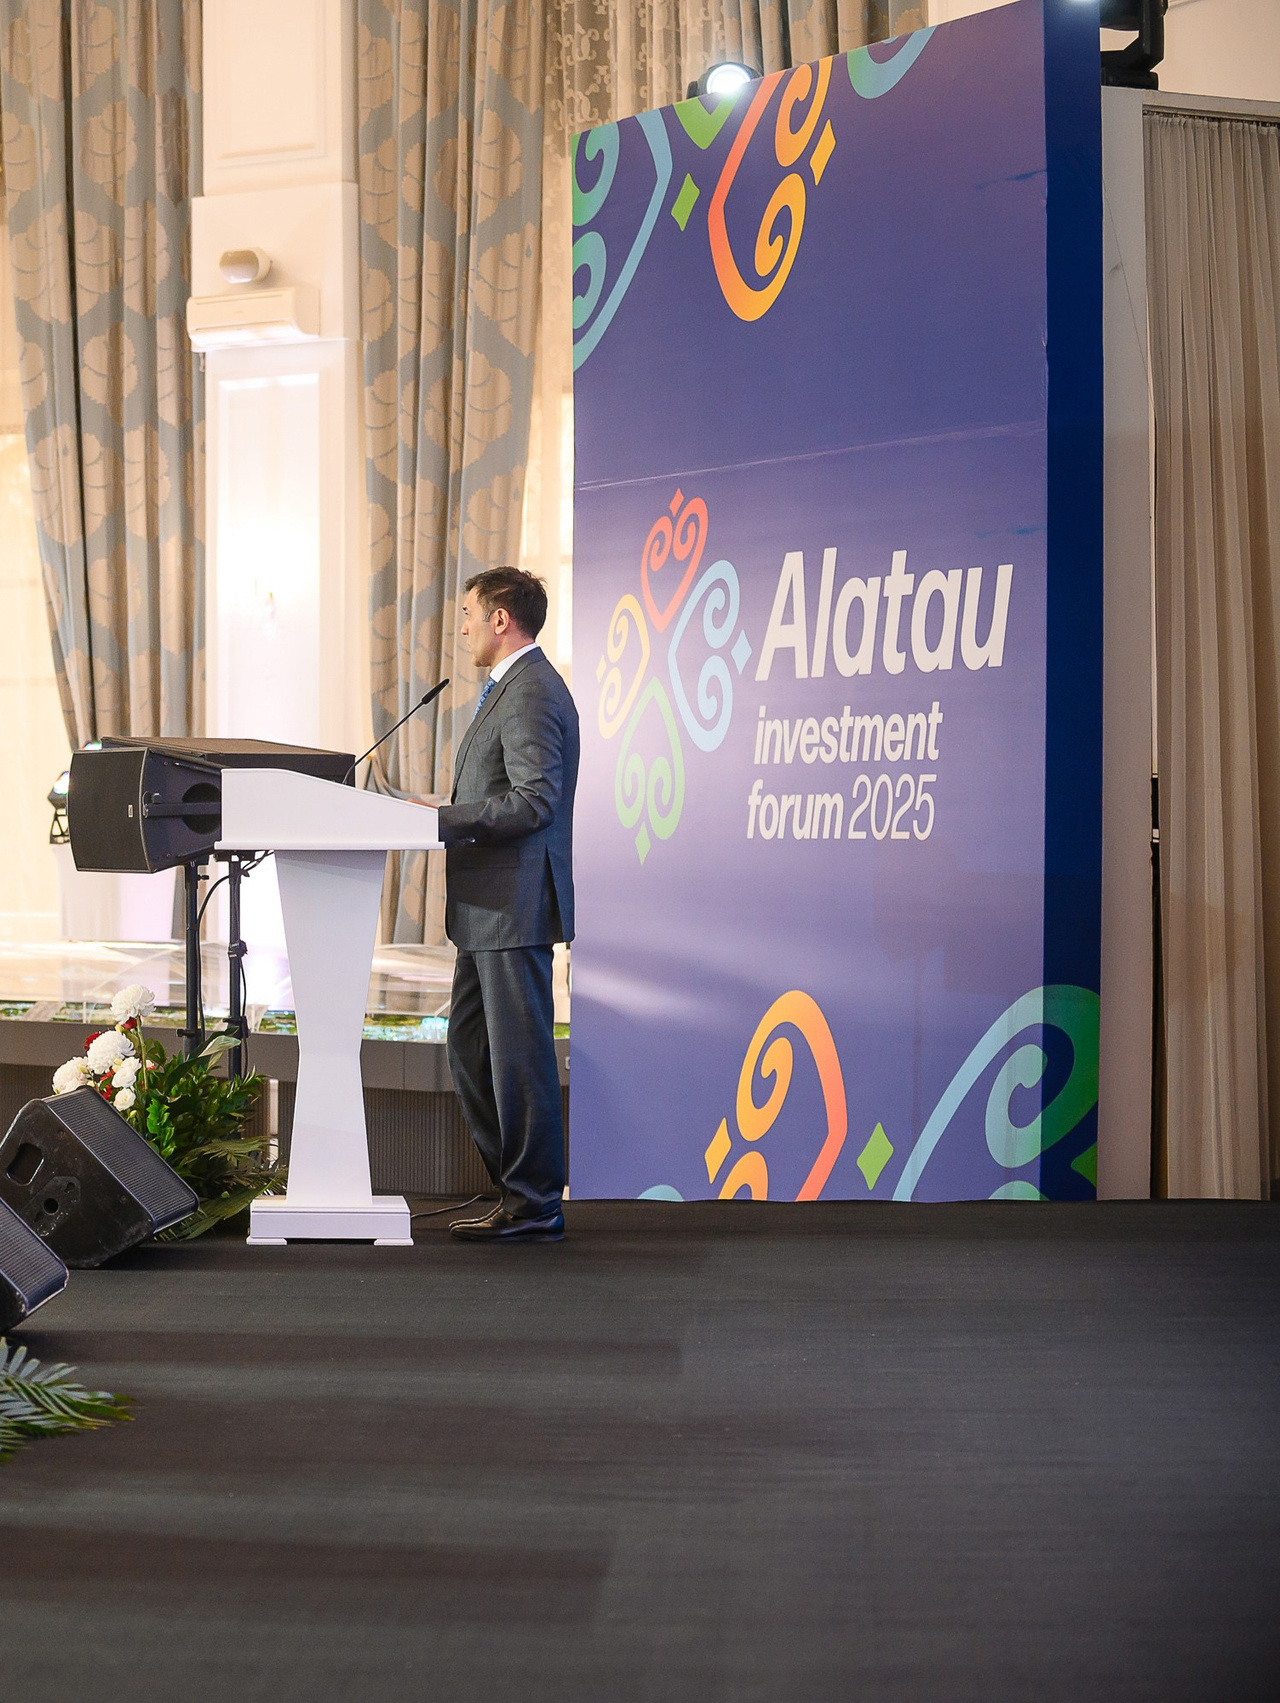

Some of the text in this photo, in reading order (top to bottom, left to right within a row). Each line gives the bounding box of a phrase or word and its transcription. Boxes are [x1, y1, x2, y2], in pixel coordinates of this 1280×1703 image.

[754, 547, 1014, 682] Alatau
[753, 701, 943, 764] investment
[746, 773, 937, 841] forum 2025
